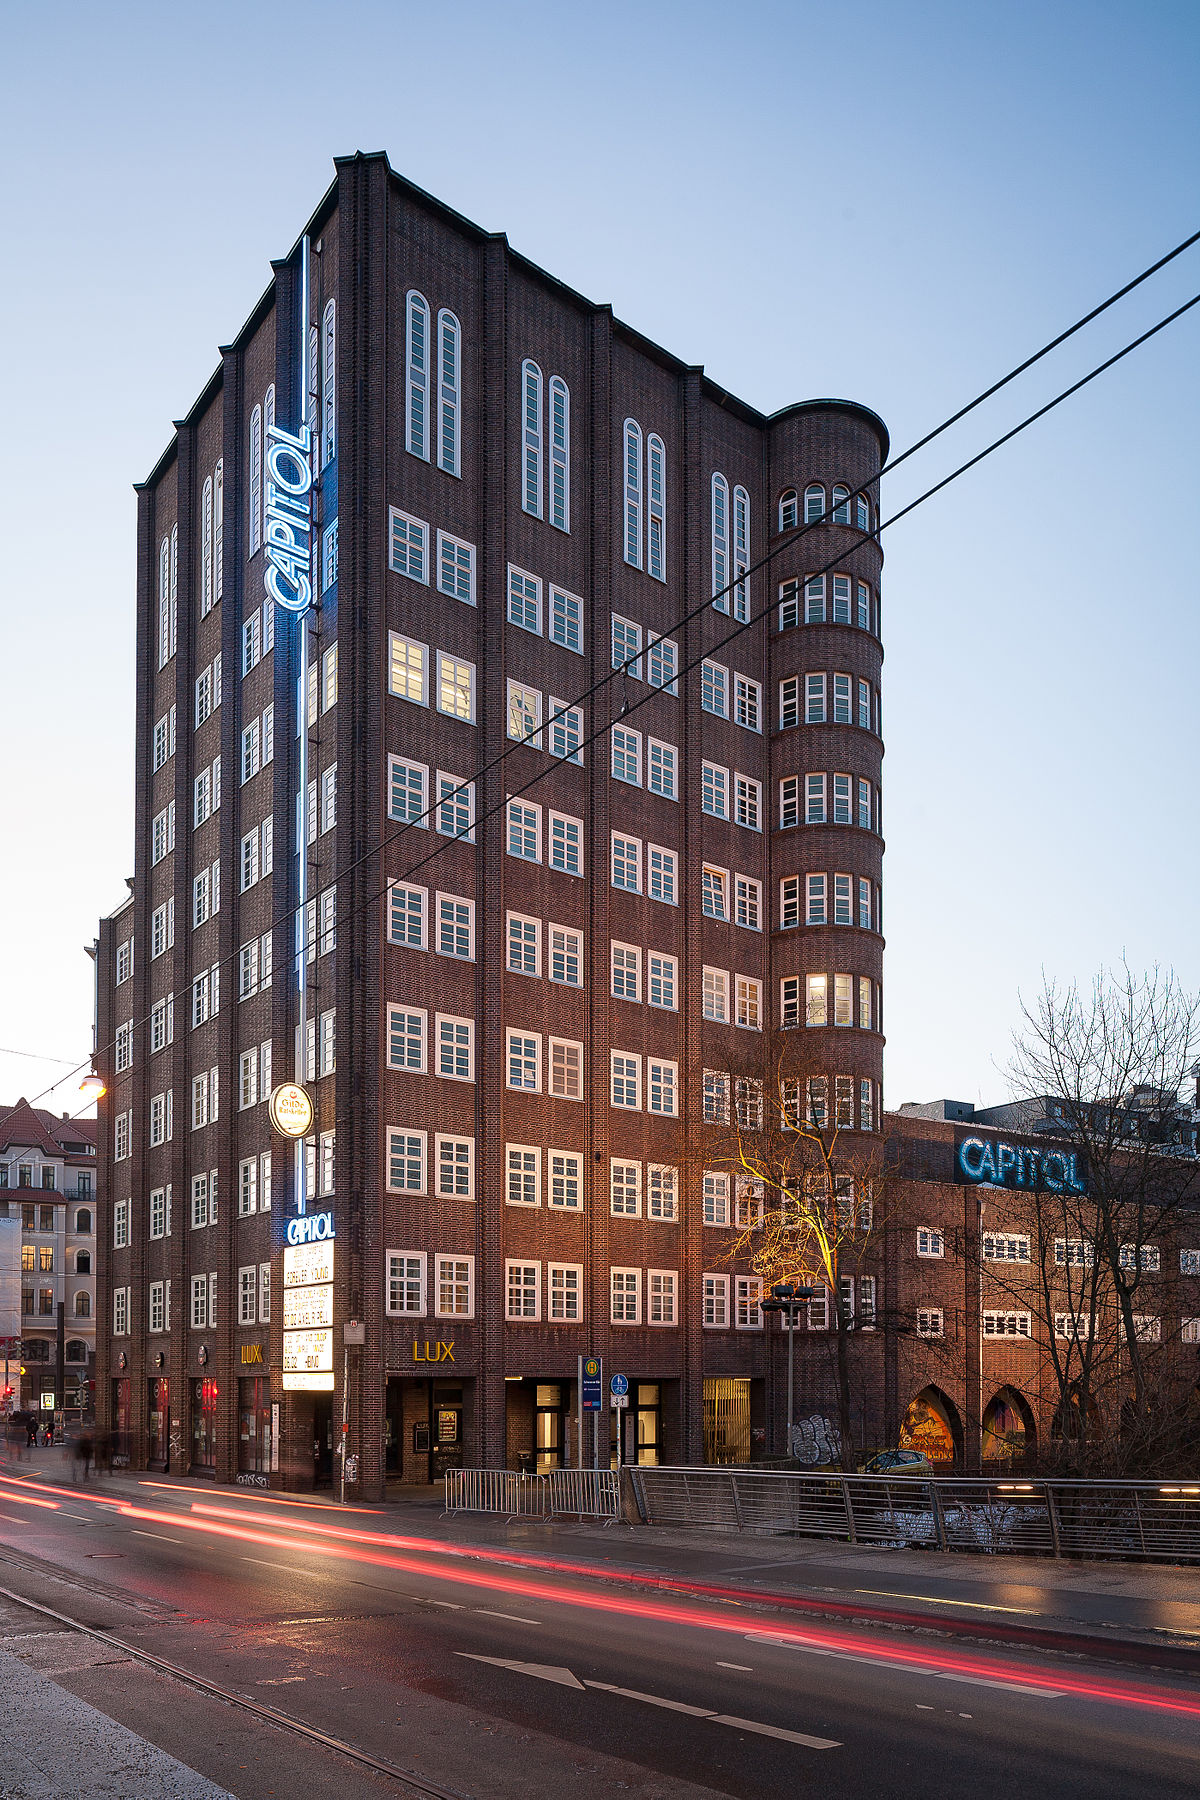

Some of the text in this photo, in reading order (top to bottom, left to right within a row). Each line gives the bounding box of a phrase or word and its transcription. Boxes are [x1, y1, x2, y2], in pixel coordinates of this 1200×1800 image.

[264, 424, 312, 612] CAPITOL
[281, 1099, 305, 1109] Gilde
[960, 1136, 1086, 1191] CAPITOL
[287, 1211, 336, 1246] CAPITOL
[286, 1265, 329, 1284] FOREVER YOUNG
[240, 1344, 264, 1364] LUX
[412, 1340, 456, 1362] LUX
